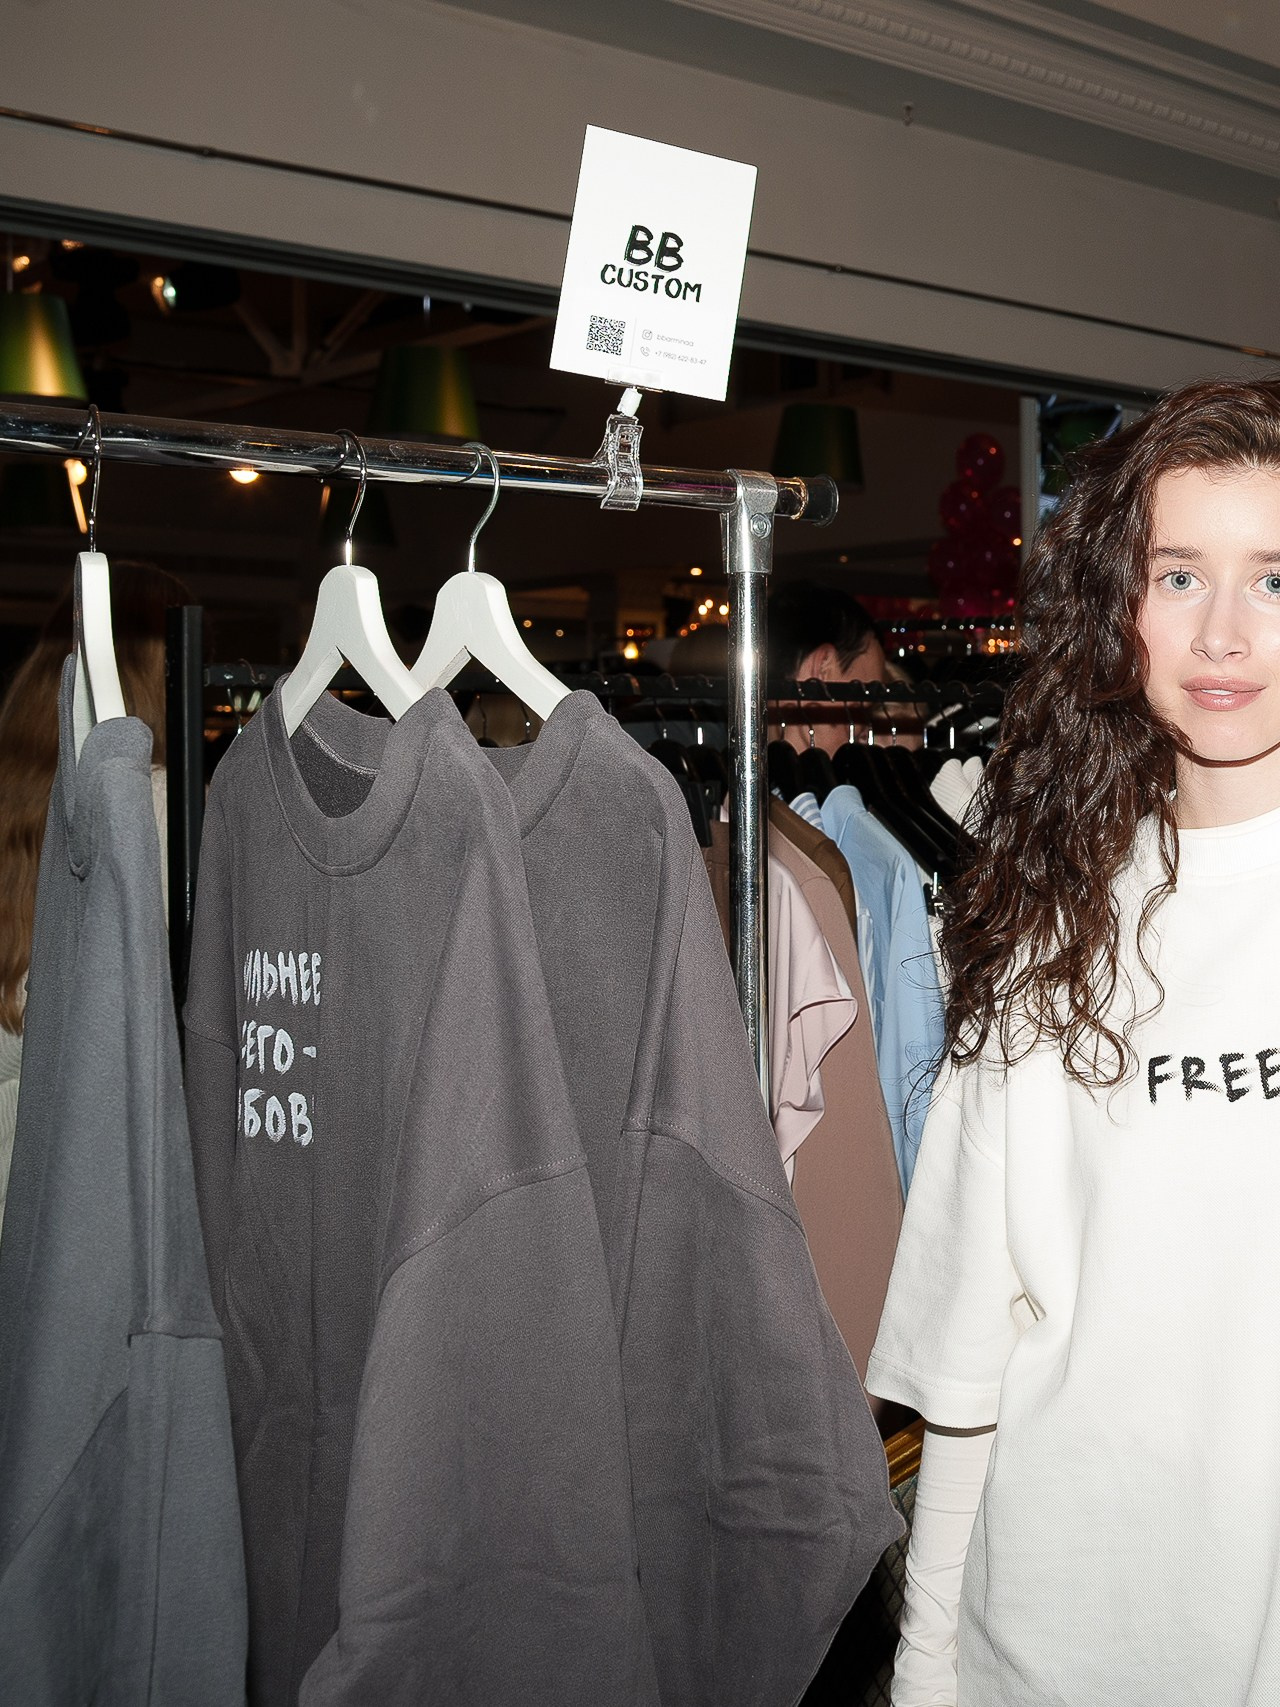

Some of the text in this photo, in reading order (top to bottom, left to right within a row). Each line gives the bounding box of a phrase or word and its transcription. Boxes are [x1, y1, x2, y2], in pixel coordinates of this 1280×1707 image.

[624, 224, 684, 272] BB
[600, 263, 702, 303] CUSTOM
[238, 1087, 314, 1147] БОВ
